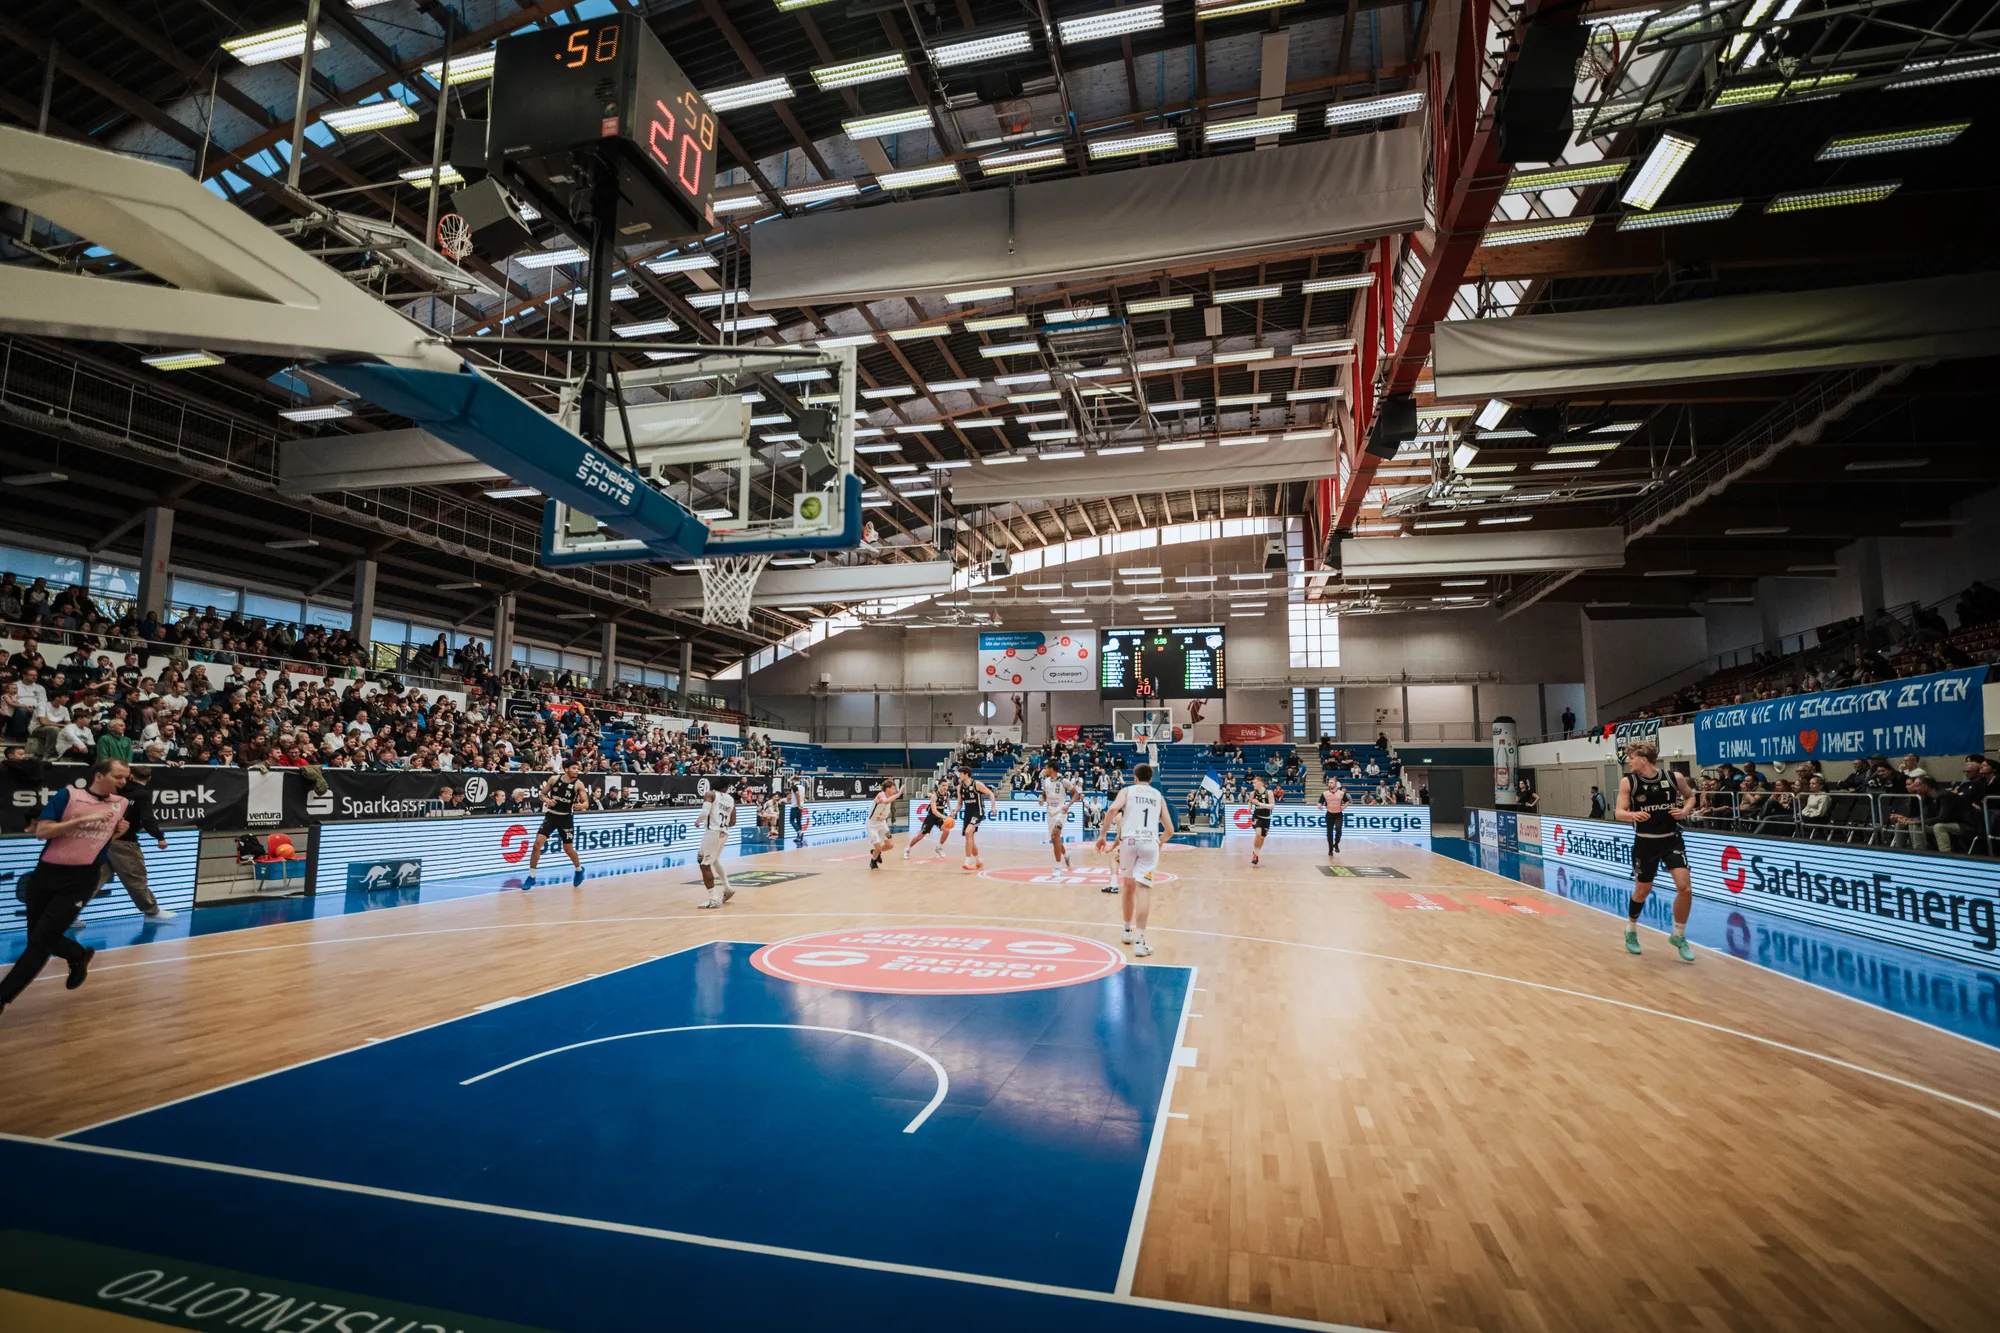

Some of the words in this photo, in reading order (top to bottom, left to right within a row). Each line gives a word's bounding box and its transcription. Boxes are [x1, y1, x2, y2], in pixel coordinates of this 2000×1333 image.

[649, 100, 702, 196] 20
[576, 465, 631, 506] Sports
[1157, 628, 1163, 636] 2
[1701, 714, 1713, 730] IN
[1715, 709, 1748, 729] GUTEN
[1751, 704, 1774, 725] WIE
[1779, 701, 1796, 721] IN
[1800, 689, 1892, 719] SCHLECHTEN
[1898, 677, 1971, 708] ZEITEN
[1719, 740, 1756, 758] EINMAL
[1760, 735, 1796, 757] TITAN
[1822, 730, 1865, 754] IMMER
[1873, 724, 1926, 750] TITAN
[1135, 796, 1157, 807] TITANS
[249, 811, 282, 820] ventura
[812, 806, 869, 827] SachsenEnergi
[1143, 808, 1149, 828] 1
[1750, 855, 1997, 951] SachsenEnerg
[879, 962, 1037, 979] Energie
[896, 955, 1058, 972] Sachsen
